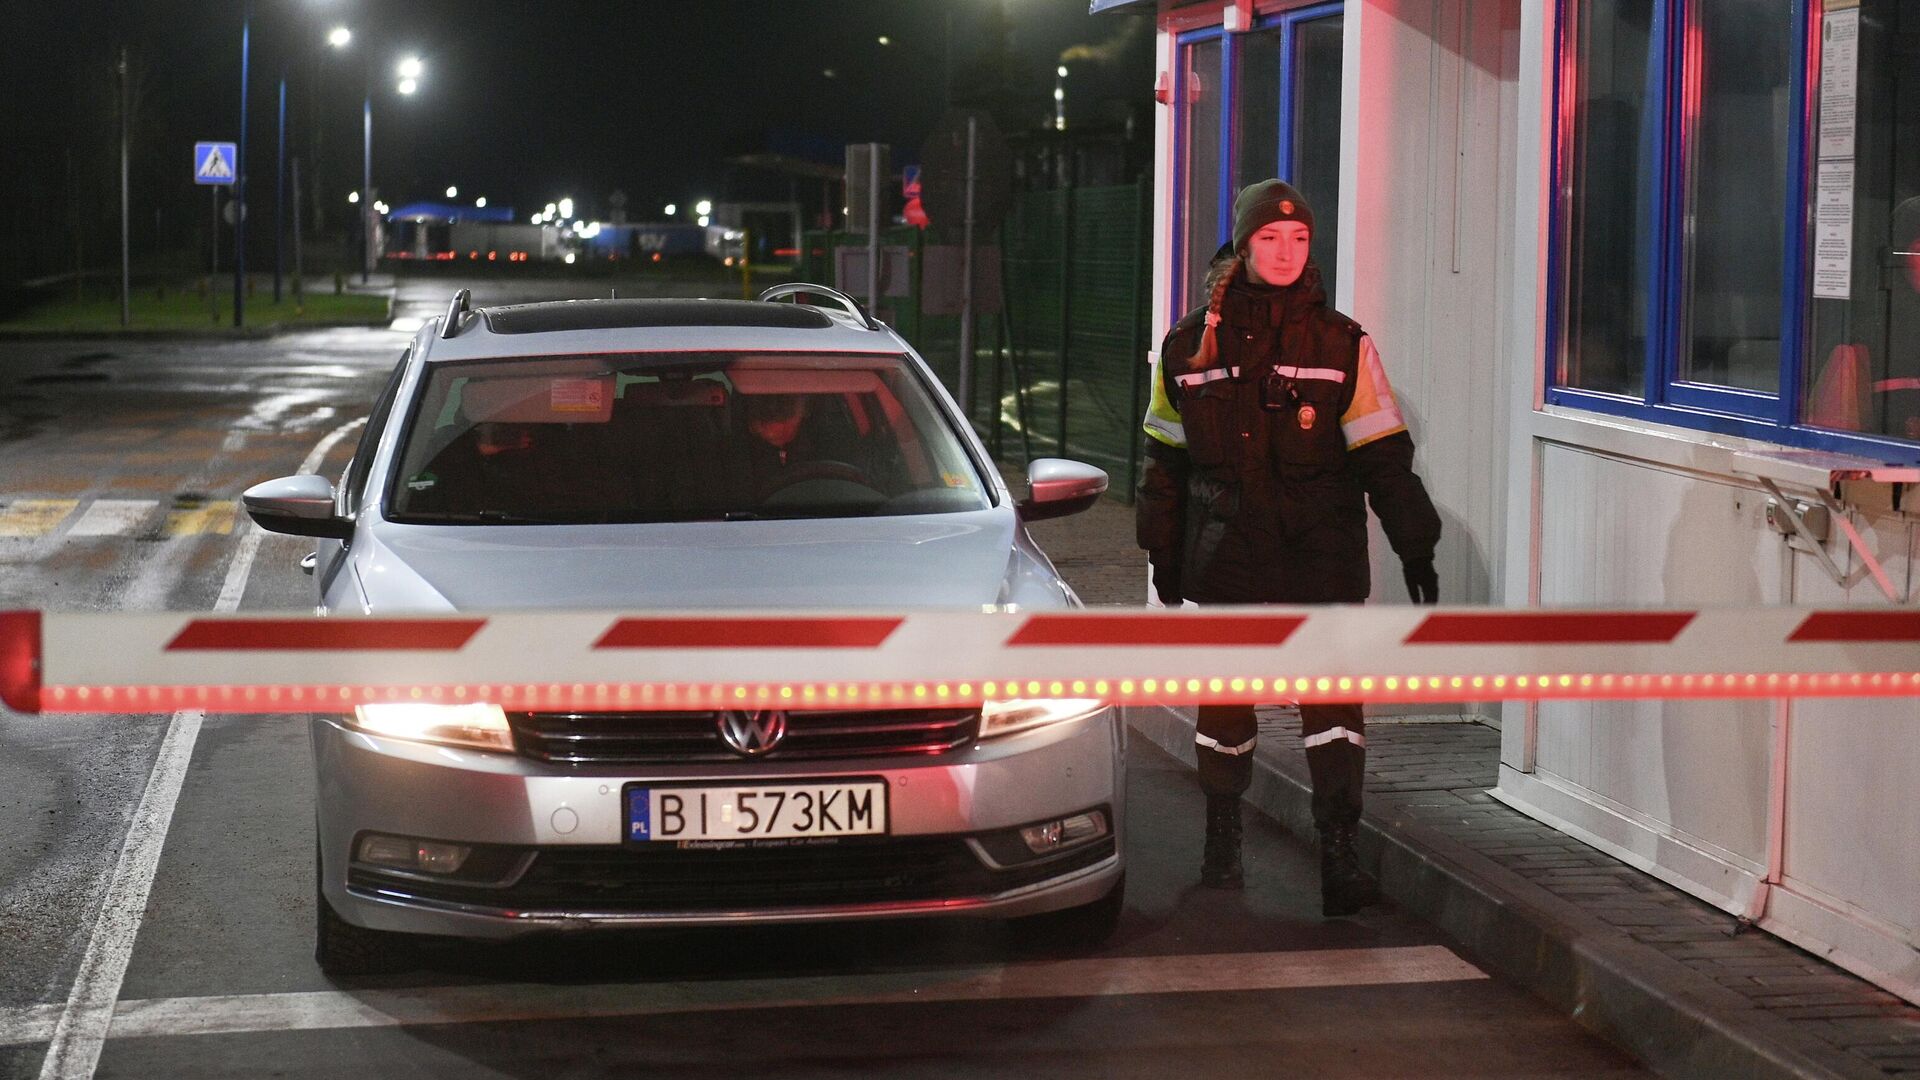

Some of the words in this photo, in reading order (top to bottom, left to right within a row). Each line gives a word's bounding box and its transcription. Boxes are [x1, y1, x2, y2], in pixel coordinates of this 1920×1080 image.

[660, 793, 707, 836] BI
[737, 789, 873, 833] 573KM
[632, 822, 648, 834] PL
